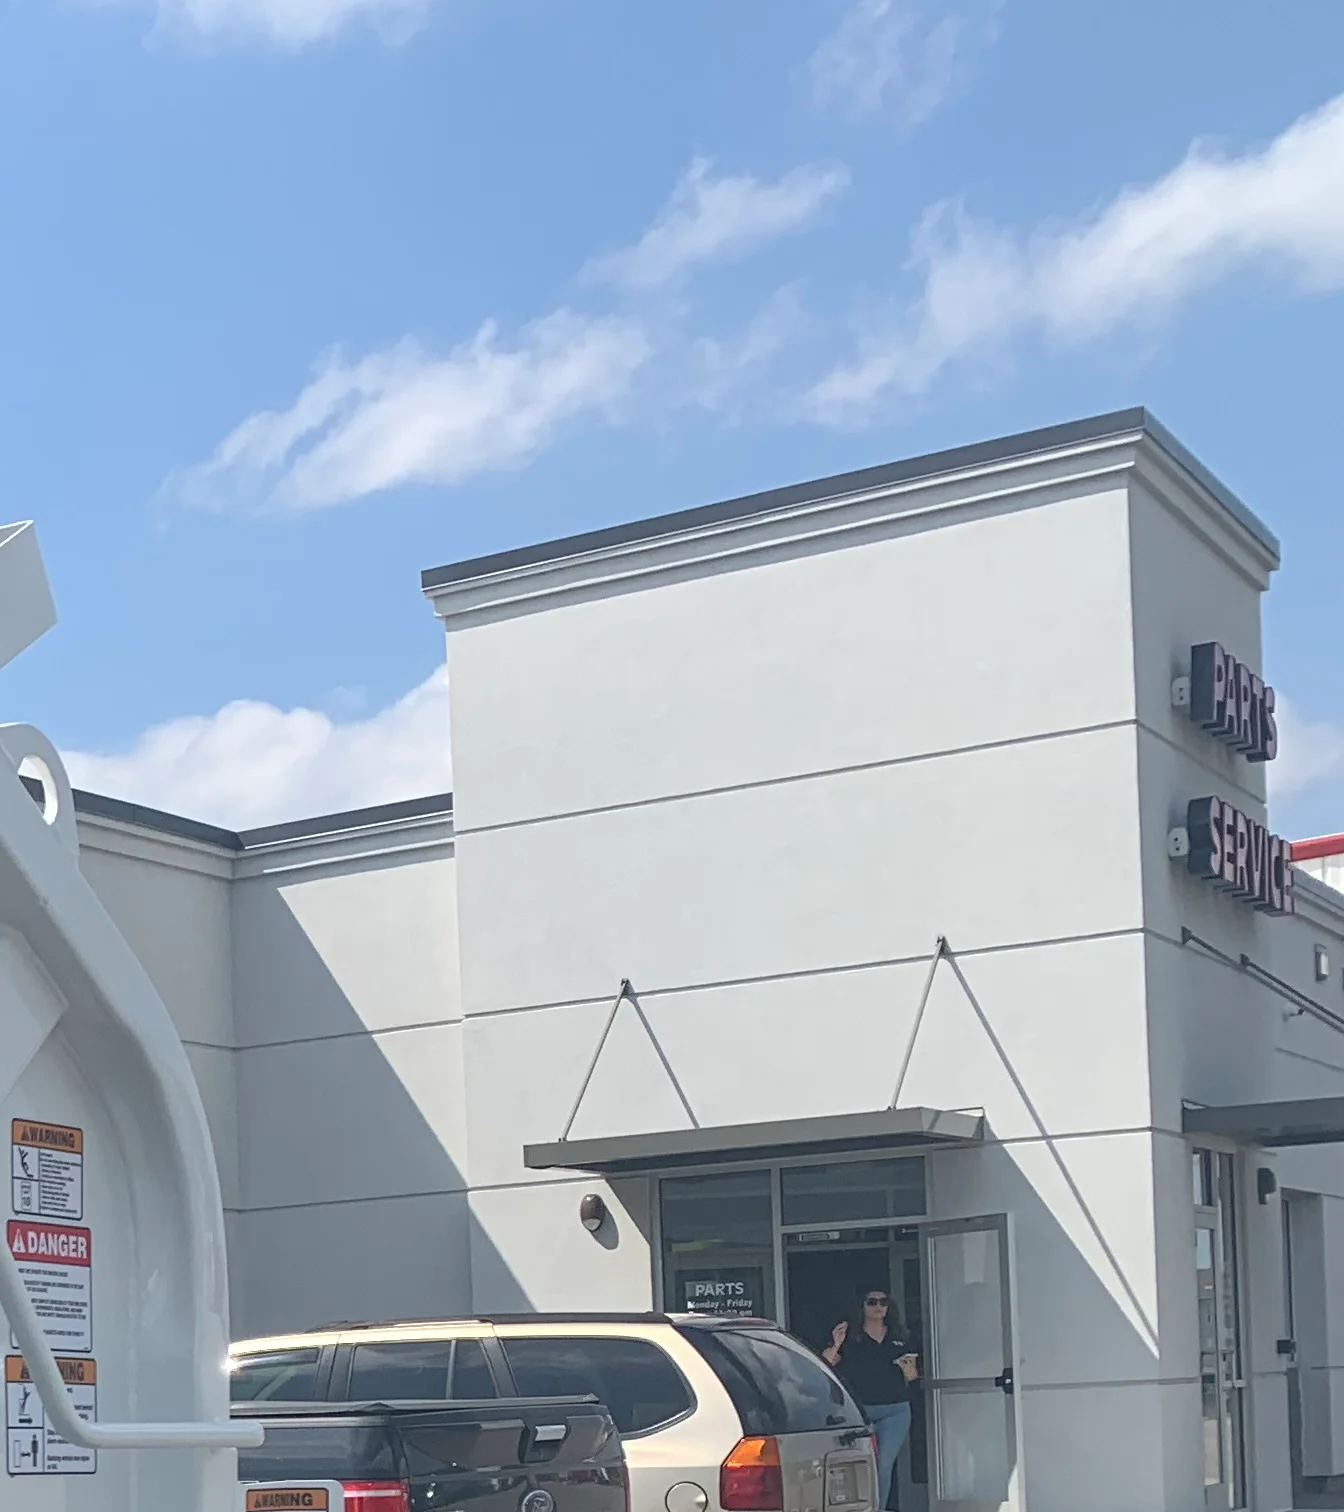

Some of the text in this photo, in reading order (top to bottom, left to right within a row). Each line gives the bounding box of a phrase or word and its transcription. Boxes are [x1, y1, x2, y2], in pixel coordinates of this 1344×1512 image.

[1211, 641, 1278, 763] PARTS
[1209, 795, 1295, 917] SERVICE
[29, 1126, 75, 1149] WARNING
[27, 1230, 87, 1259] DANGER
[695, 1281, 745, 1297] PARTS
[726, 1299, 753, 1308] Friday
[260, 1492, 314, 1508] WARNING
